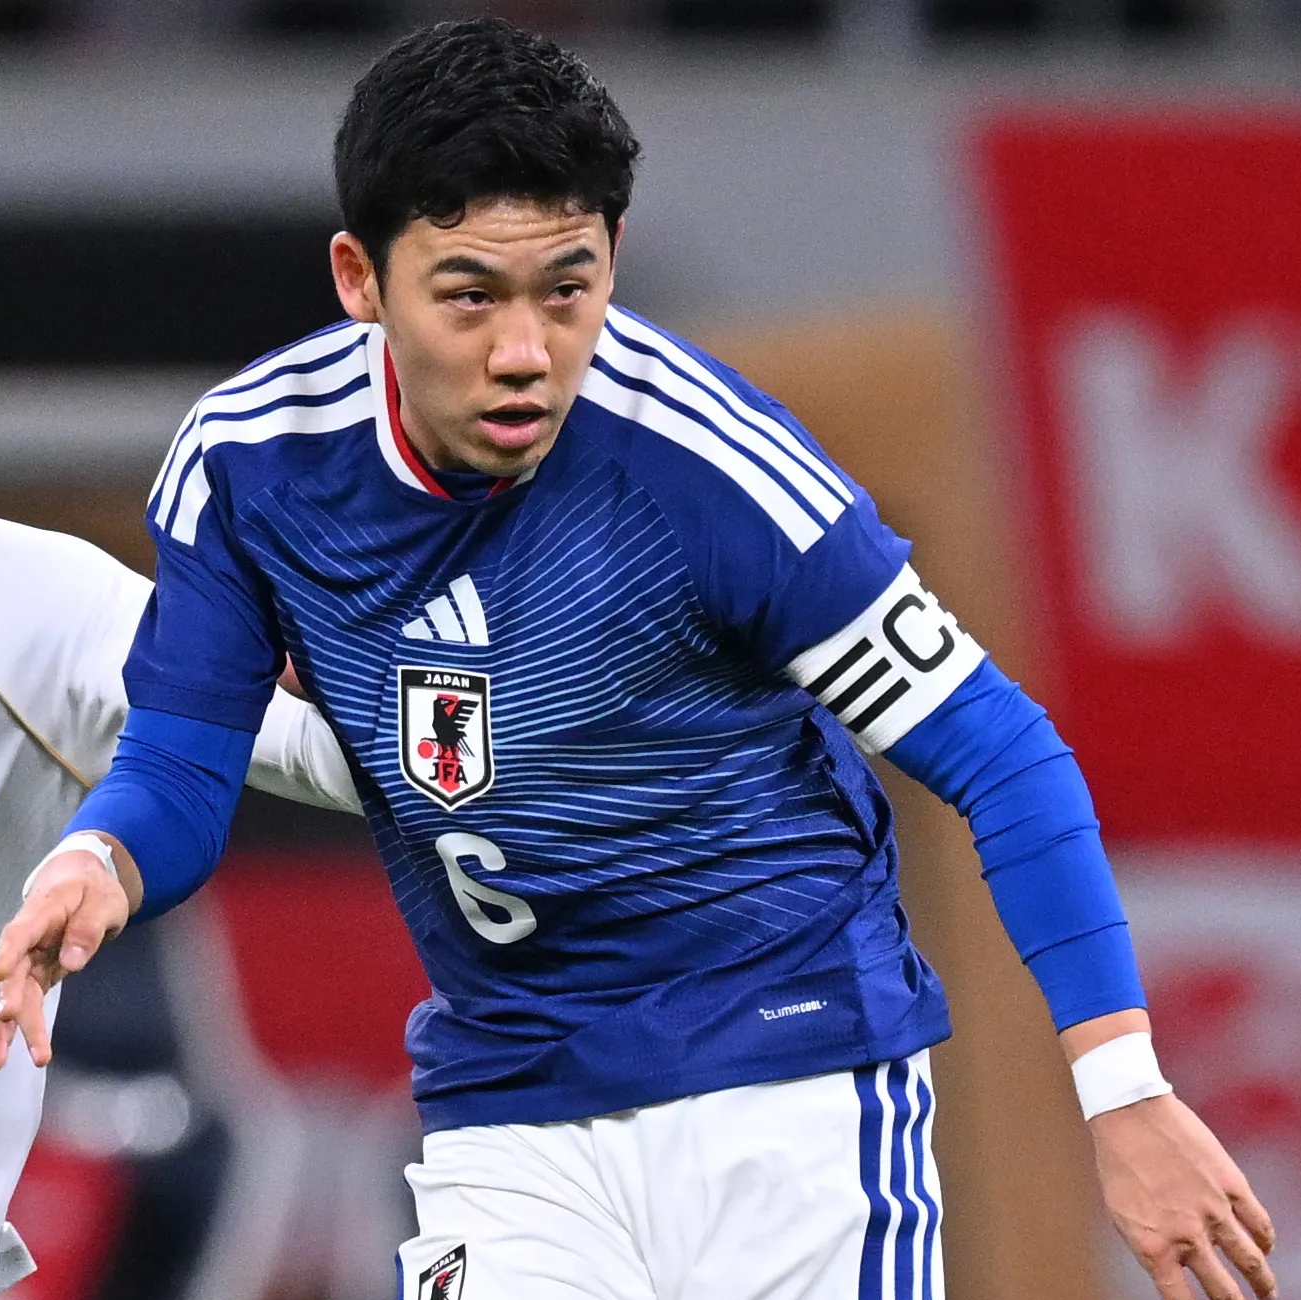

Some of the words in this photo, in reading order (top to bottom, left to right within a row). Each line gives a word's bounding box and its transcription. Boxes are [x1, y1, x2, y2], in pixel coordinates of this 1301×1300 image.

[424, 673, 470, 688] JAPAN
[428, 762, 468, 784] JFA
[435, 832, 537, 944] 6
[763, 1000, 823, 1020] CLIMACOOL
[430, 1252, 456, 1276] JAPAN
